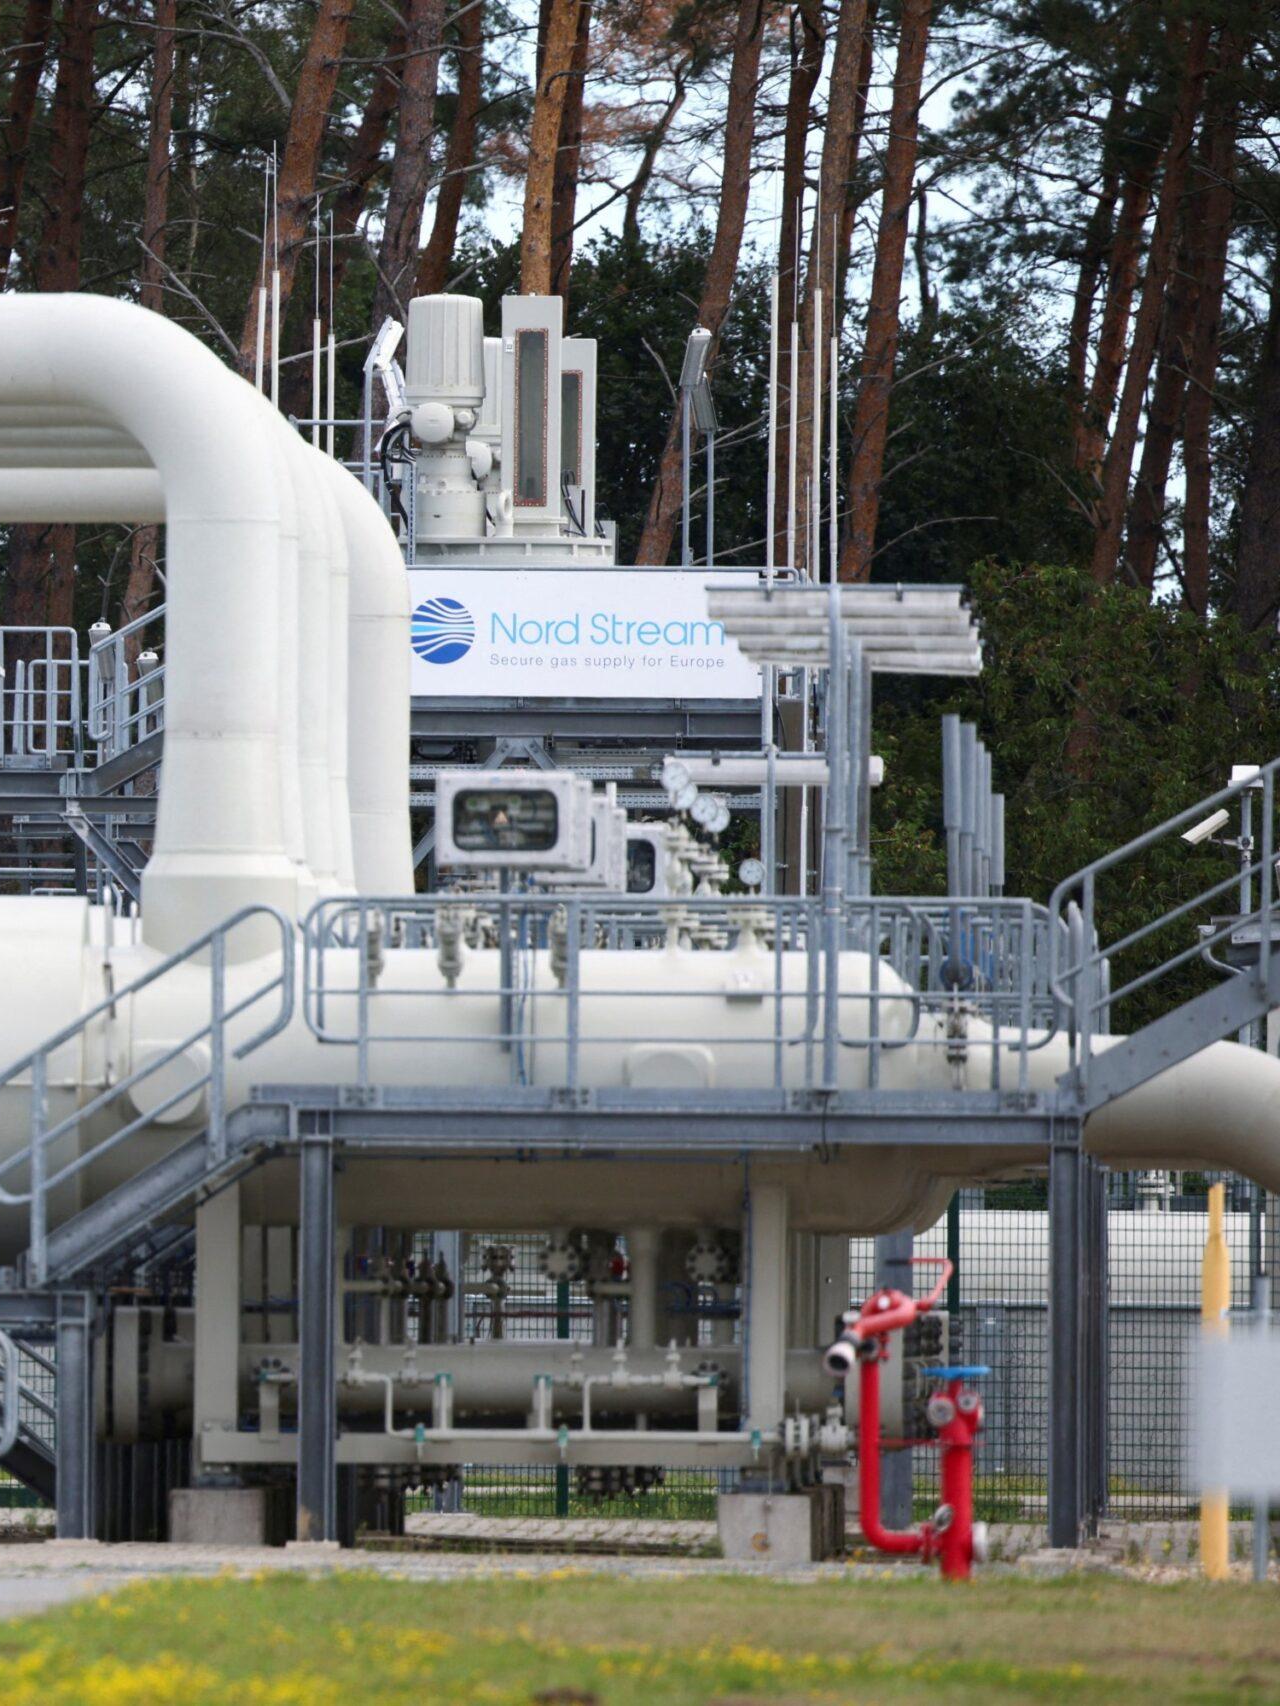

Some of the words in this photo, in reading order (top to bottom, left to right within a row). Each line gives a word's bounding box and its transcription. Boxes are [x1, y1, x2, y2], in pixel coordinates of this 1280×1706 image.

[490, 611, 580, 646] Nord
[589, 611, 725, 647] Stream
[489, 652, 544, 667] Secure
[550, 656, 577, 669] gas
[584, 653, 636, 670] supply
[641, 654, 663, 668] for
[670, 654, 725, 670] Europe
